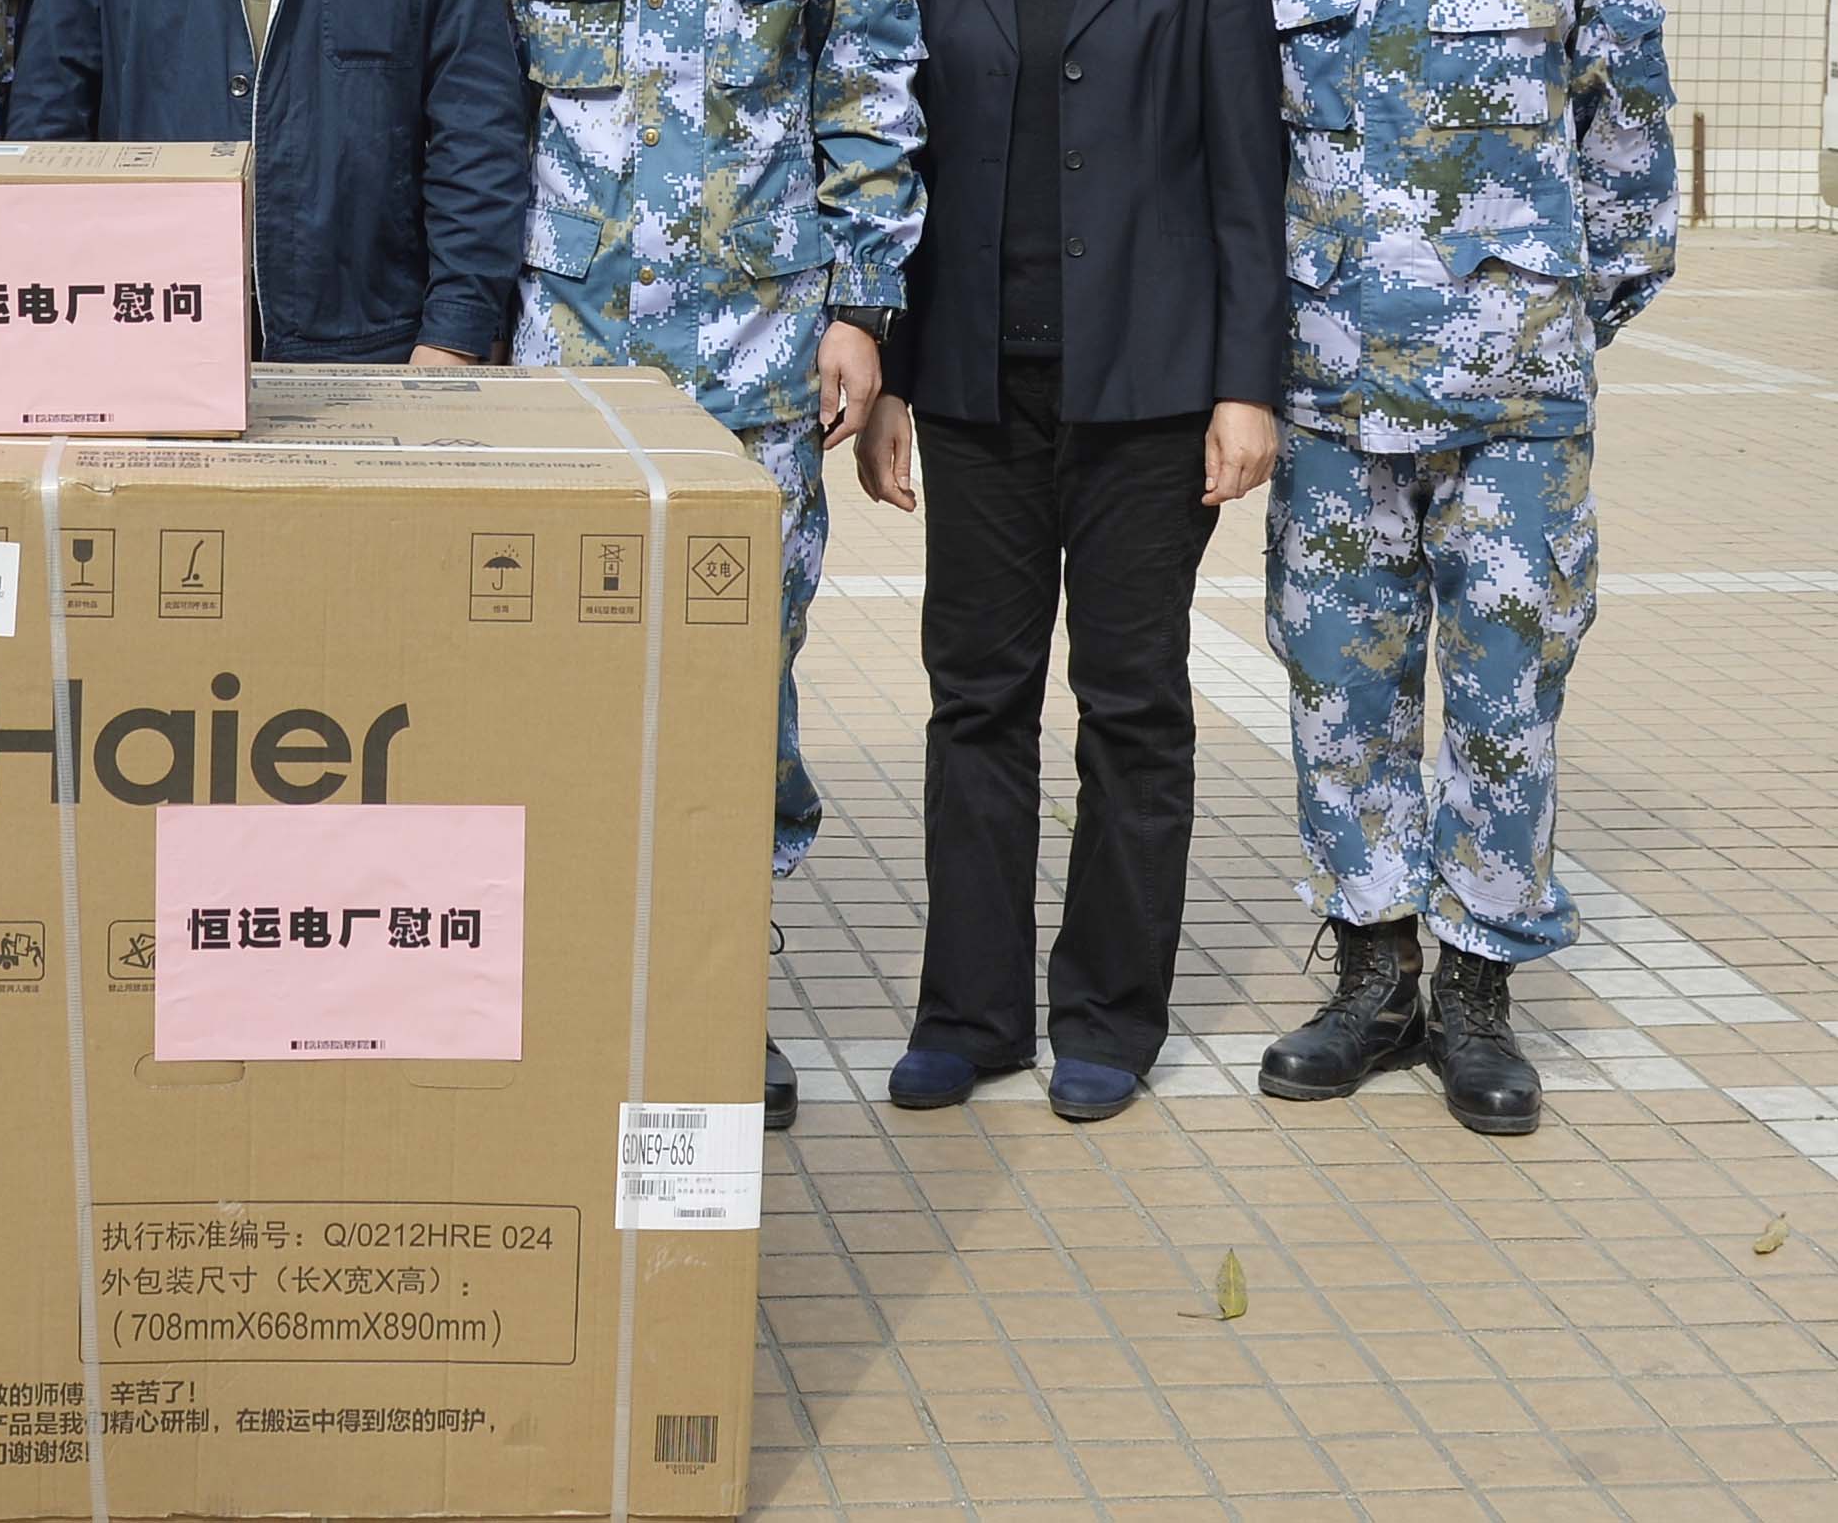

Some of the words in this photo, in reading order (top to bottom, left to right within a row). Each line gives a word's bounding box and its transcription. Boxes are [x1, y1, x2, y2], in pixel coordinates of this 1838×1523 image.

[706, 560, 732, 579] 交电
[187, 905, 482, 952] 恒运电厂慰问
[622, 1132, 695, 1166] GDNE9-636
[502, 1225, 553, 1251] 024
[112, 1309, 503, 1348] (708mmX668mmX890mm)
